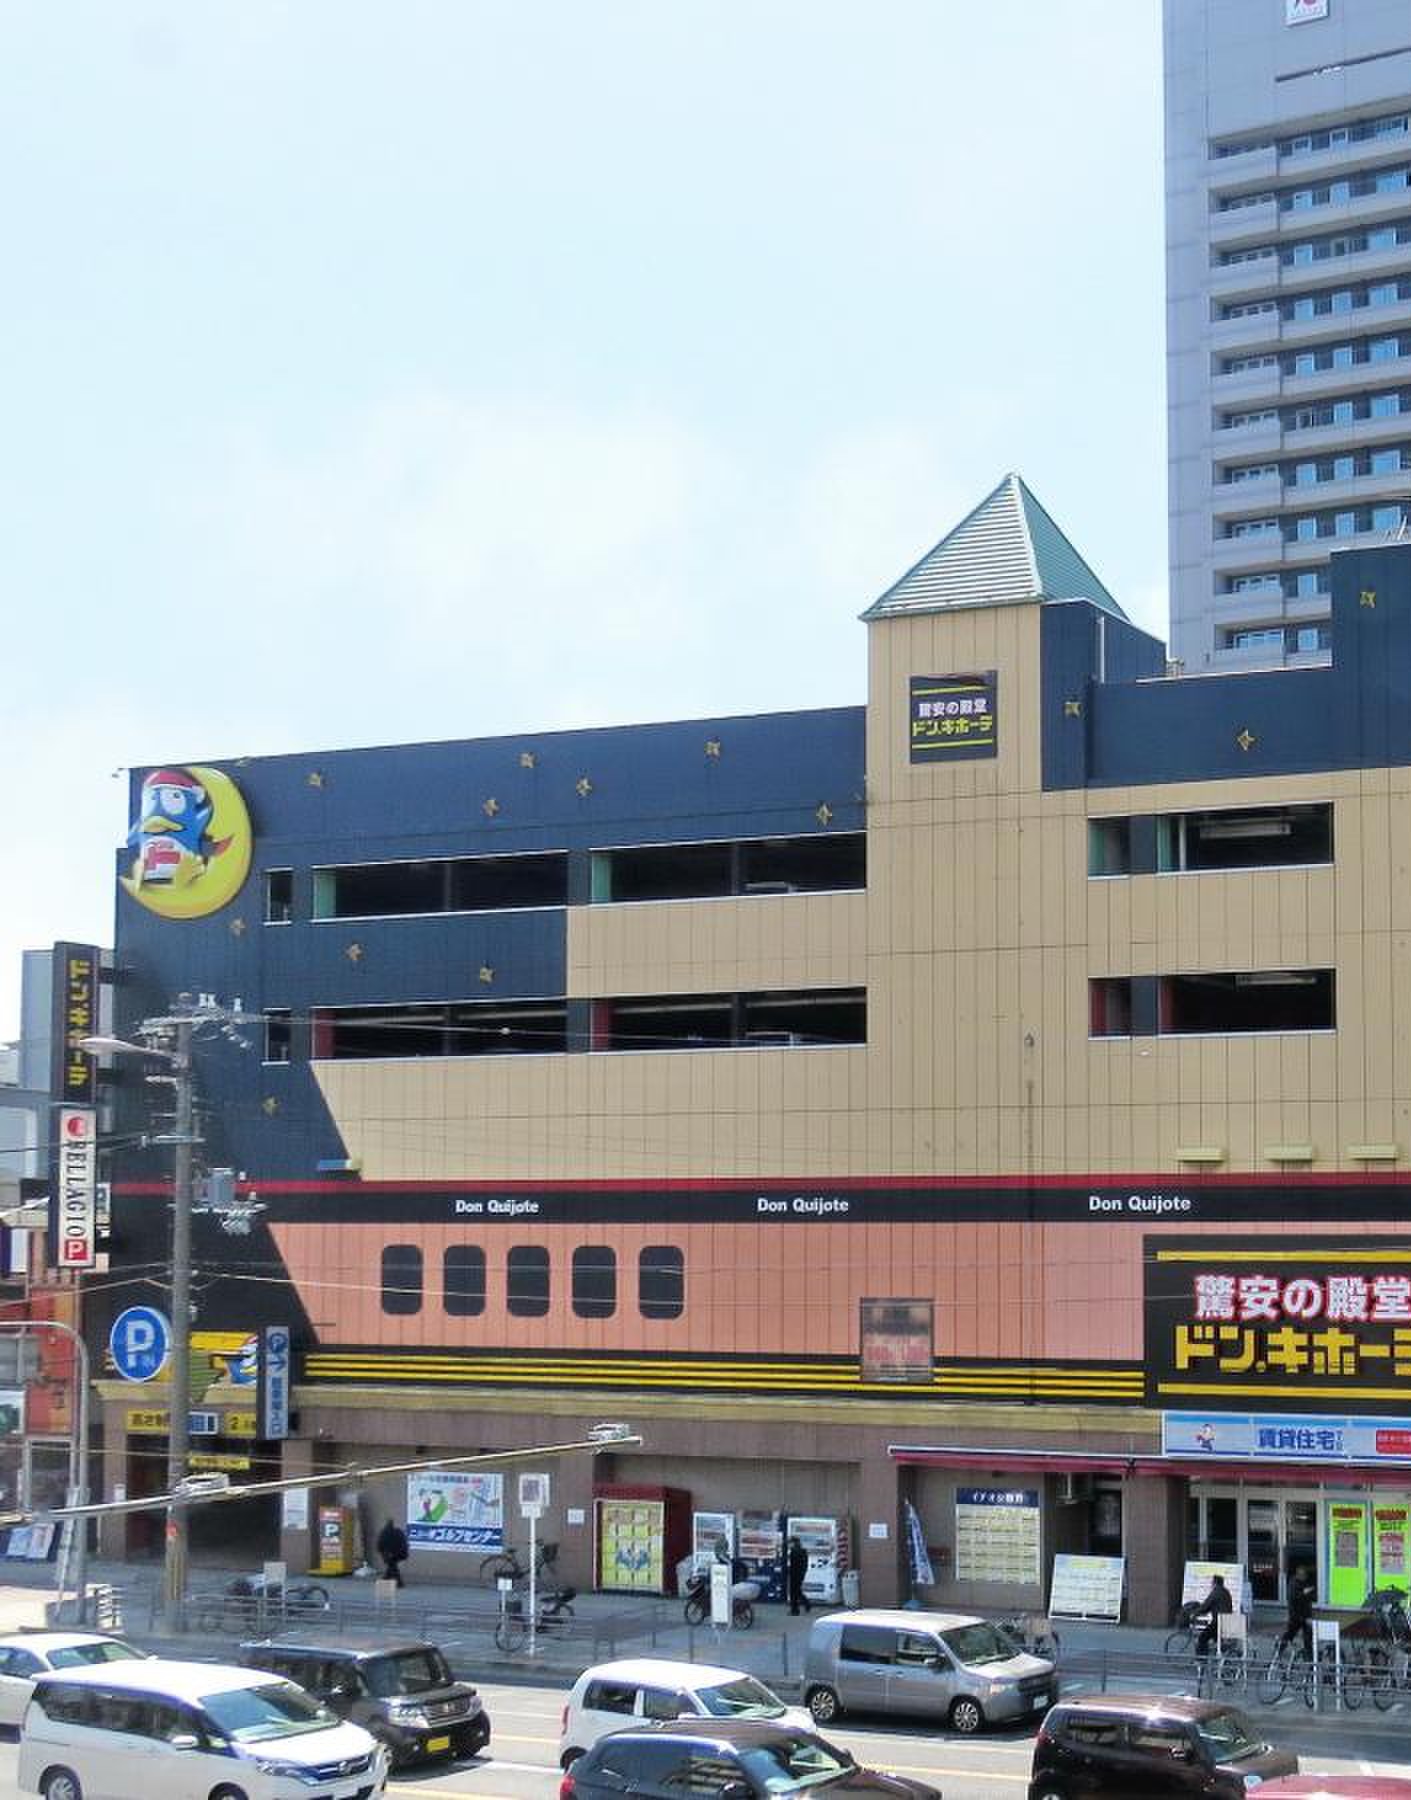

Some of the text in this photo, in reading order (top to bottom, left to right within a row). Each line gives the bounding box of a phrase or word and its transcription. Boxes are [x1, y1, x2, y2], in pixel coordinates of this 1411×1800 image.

[455, 1199, 539, 1216] Don Quijote
[757, 1197, 848, 1215] Don Quijote
[1089, 1195, 1191, 1214] Don Quijote
[68, 1241, 84, 1259] P
[127, 1320, 151, 1367] P
[325, 1523, 339, 1538] P
